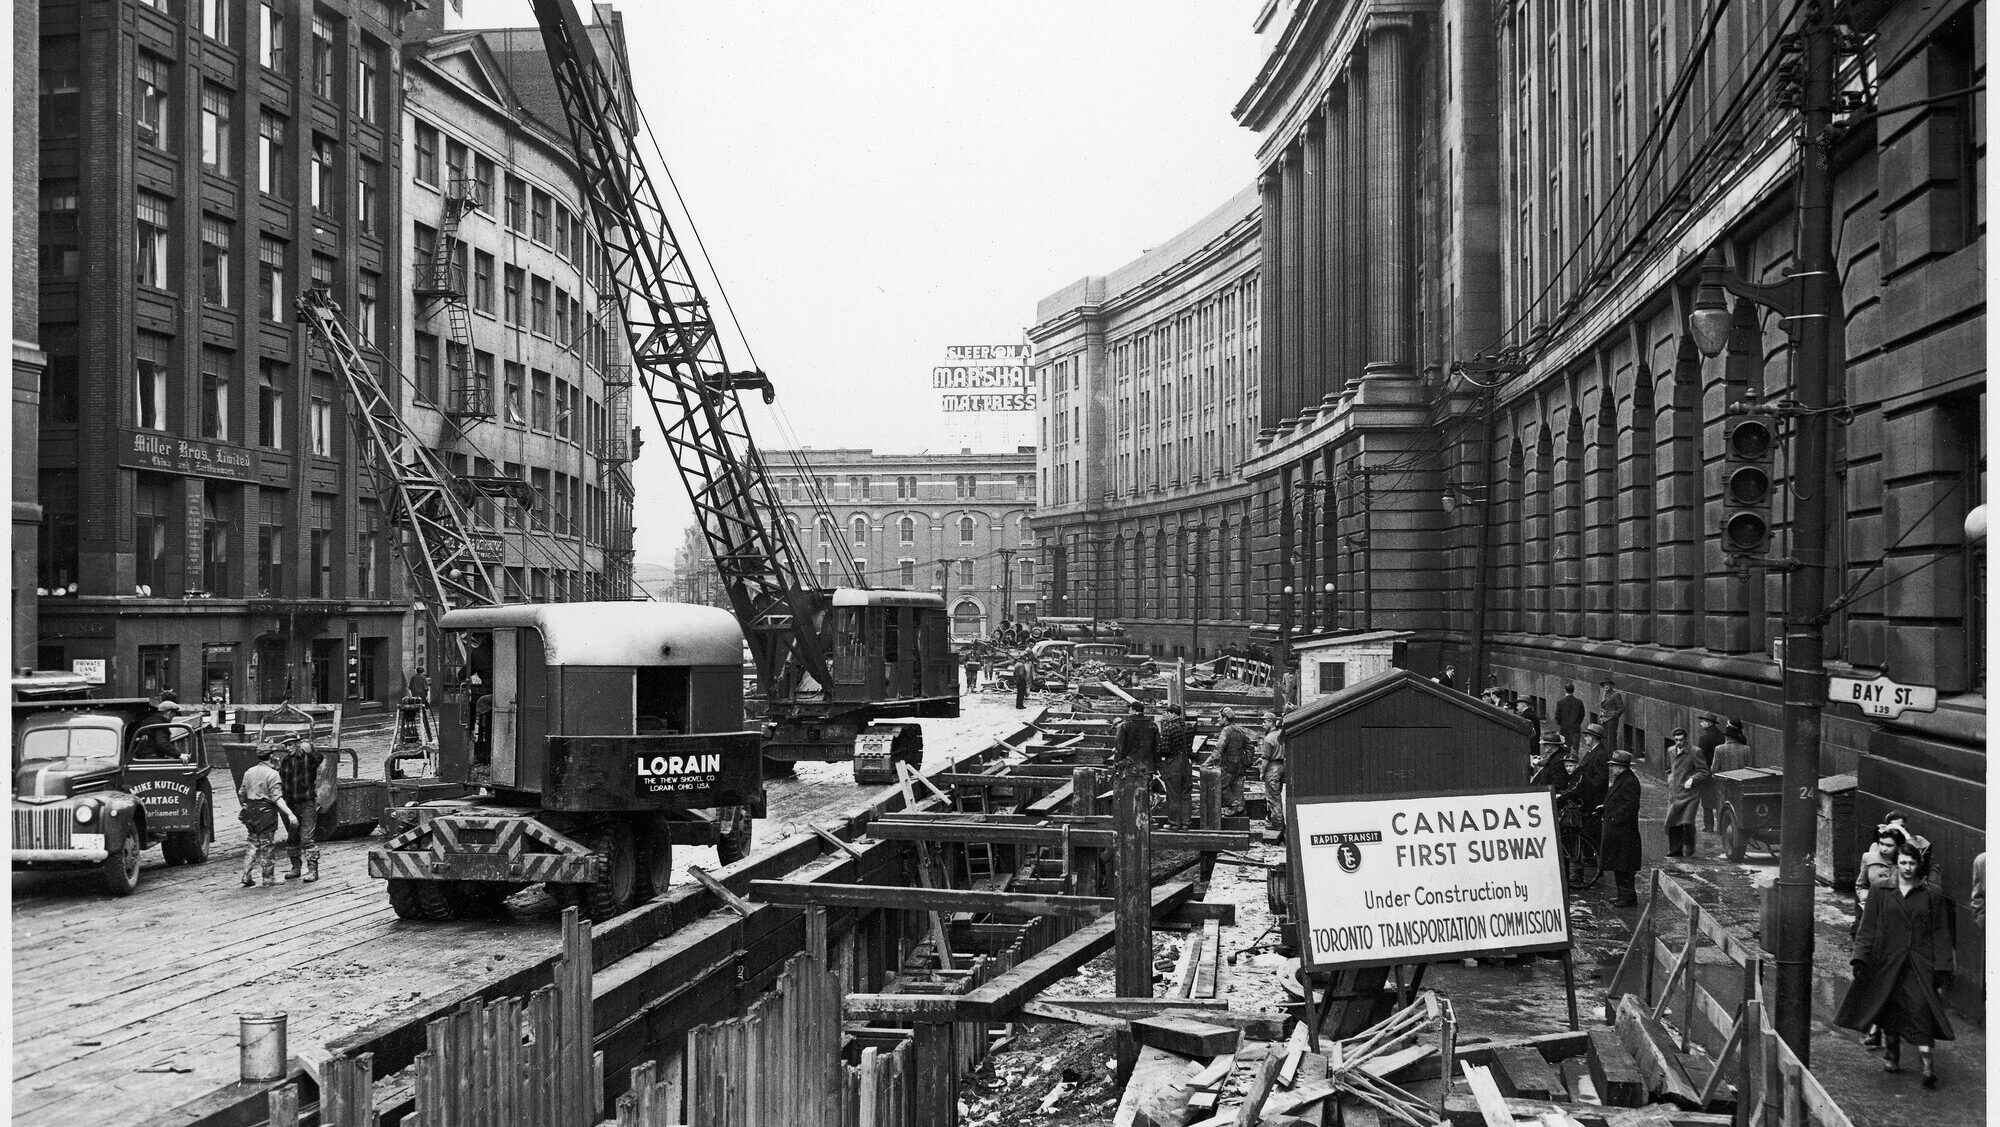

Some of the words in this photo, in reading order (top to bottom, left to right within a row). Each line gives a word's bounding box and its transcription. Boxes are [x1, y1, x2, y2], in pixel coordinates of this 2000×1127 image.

[946, 346, 990, 359] SLEEP
[994, 346, 1015, 359] ON
[1020, 346, 1031, 359] A
[134, 434, 172, 455] Miller
[216, 449, 250, 467] Limited
[1852, 683, 1884, 702] BAY
[1894, 688, 1913, 705] ST.
[1874, 705, 1890, 714] 139
[638, 754, 720, 776] LORAIN
[660, 776, 678, 784] THEW
[680, 775, 703, 783] SHOVEL
[129, 781, 152, 795] MIKE
[154, 780, 190, 795] KUTLICH
[1799, 786, 1814, 799] 24
[140, 796, 179, 805] CARTAGE
[146, 809, 179, 818] arliament
[1392, 804, 1542, 836] CANADA'S
[1313, 835, 1339, 845] RAPID
[1342, 832, 1379, 842] TRANSIT
[1396, 842, 1457, 868] FIRST
[1468, 837, 1547, 863] SUBWAY
[1364, 890, 1412, 910] Under
[1414, 881, 1512, 906] Construction
[1514, 880, 1529, 902] by
[1313, 925, 1374, 954] TORONTO
[1378, 915, 1487, 948] TRANSPORTATION
[1490, 908, 1563, 939] COMMISSION
